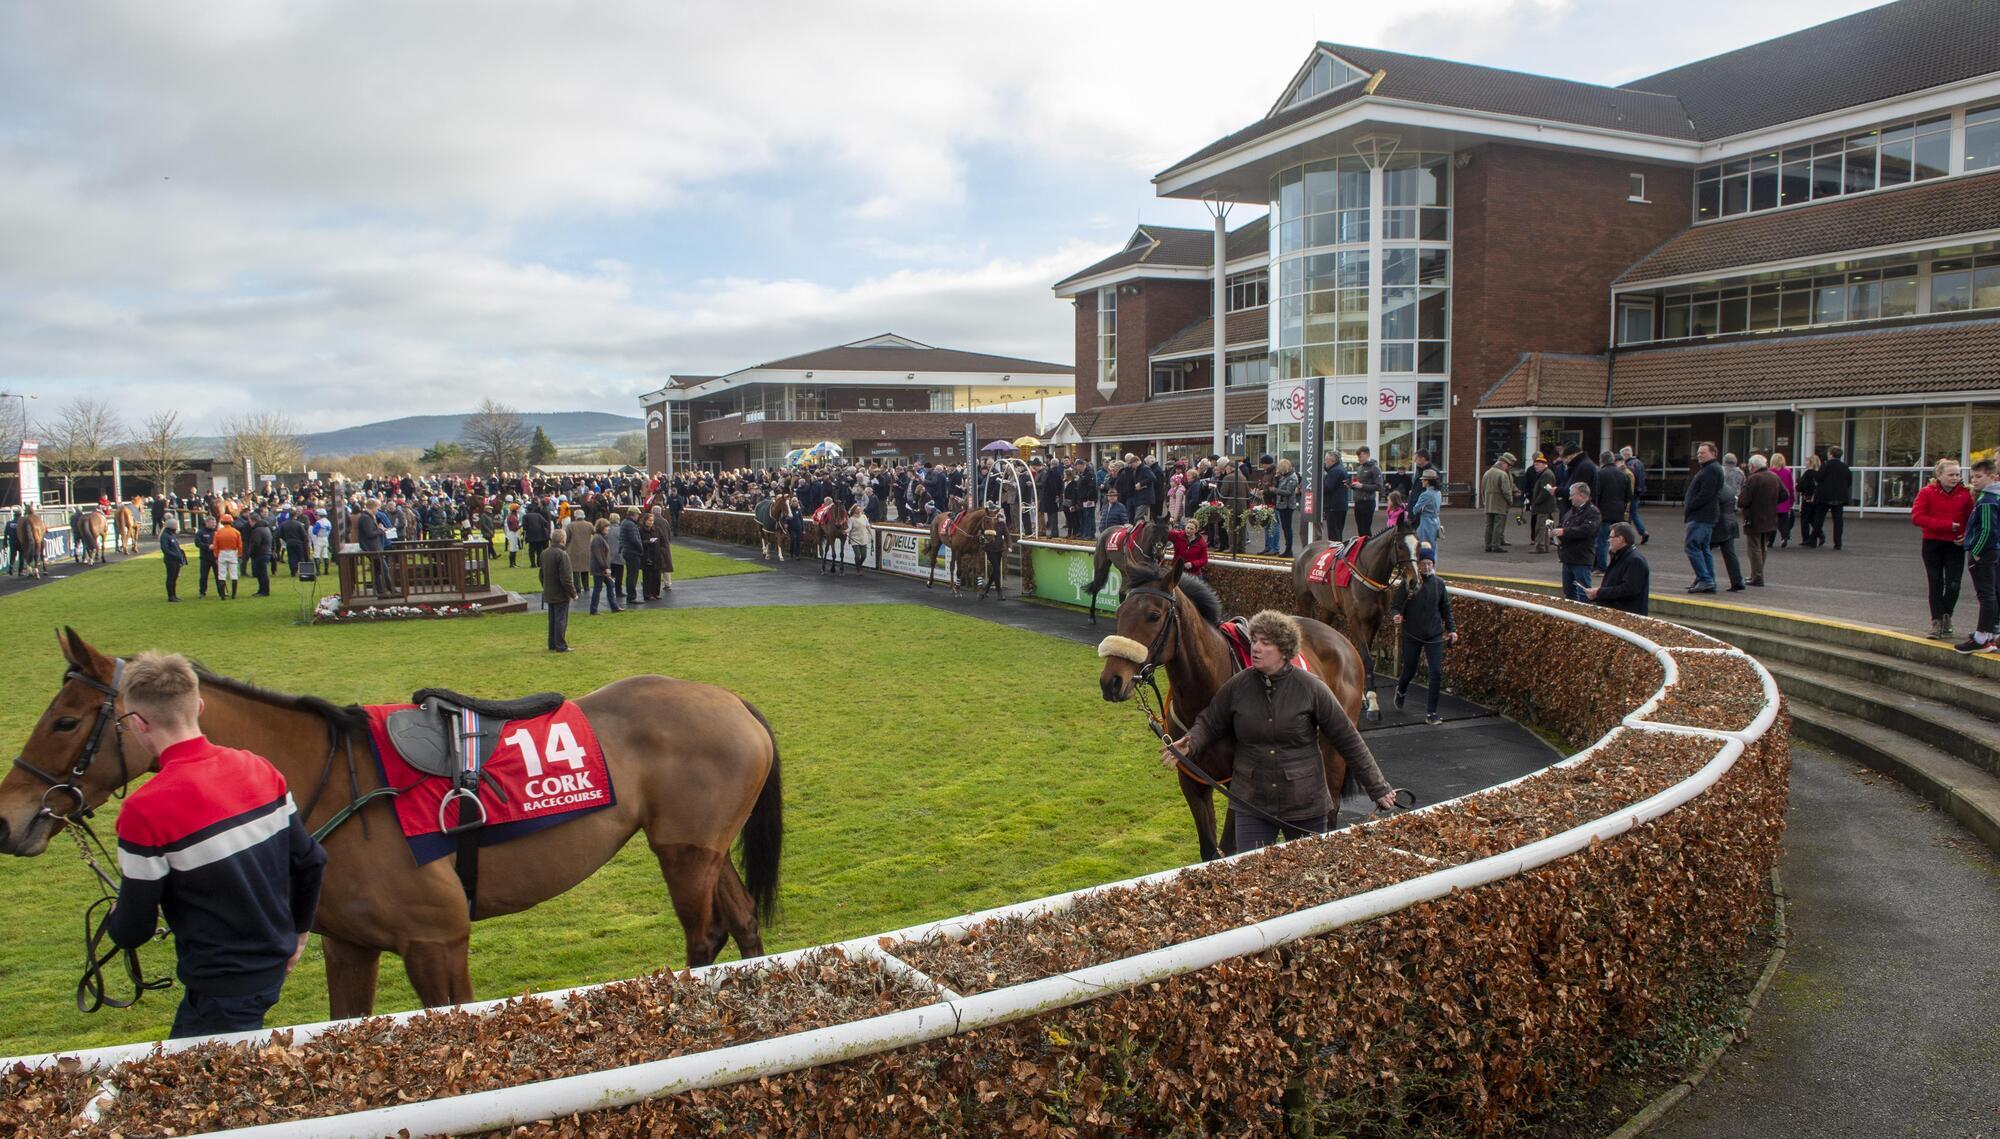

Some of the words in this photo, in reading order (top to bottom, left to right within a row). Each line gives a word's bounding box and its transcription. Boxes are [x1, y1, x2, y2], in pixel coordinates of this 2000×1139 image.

[1230, 432, 1243, 454] 1st
[1306, 386, 1314, 490] MANSIONBET
[1317, 552, 1331, 569] 4
[504, 722, 586, 778] 14
[525, 771, 594, 799] CORK
[523, 789, 604, 812] RACECOURSE
